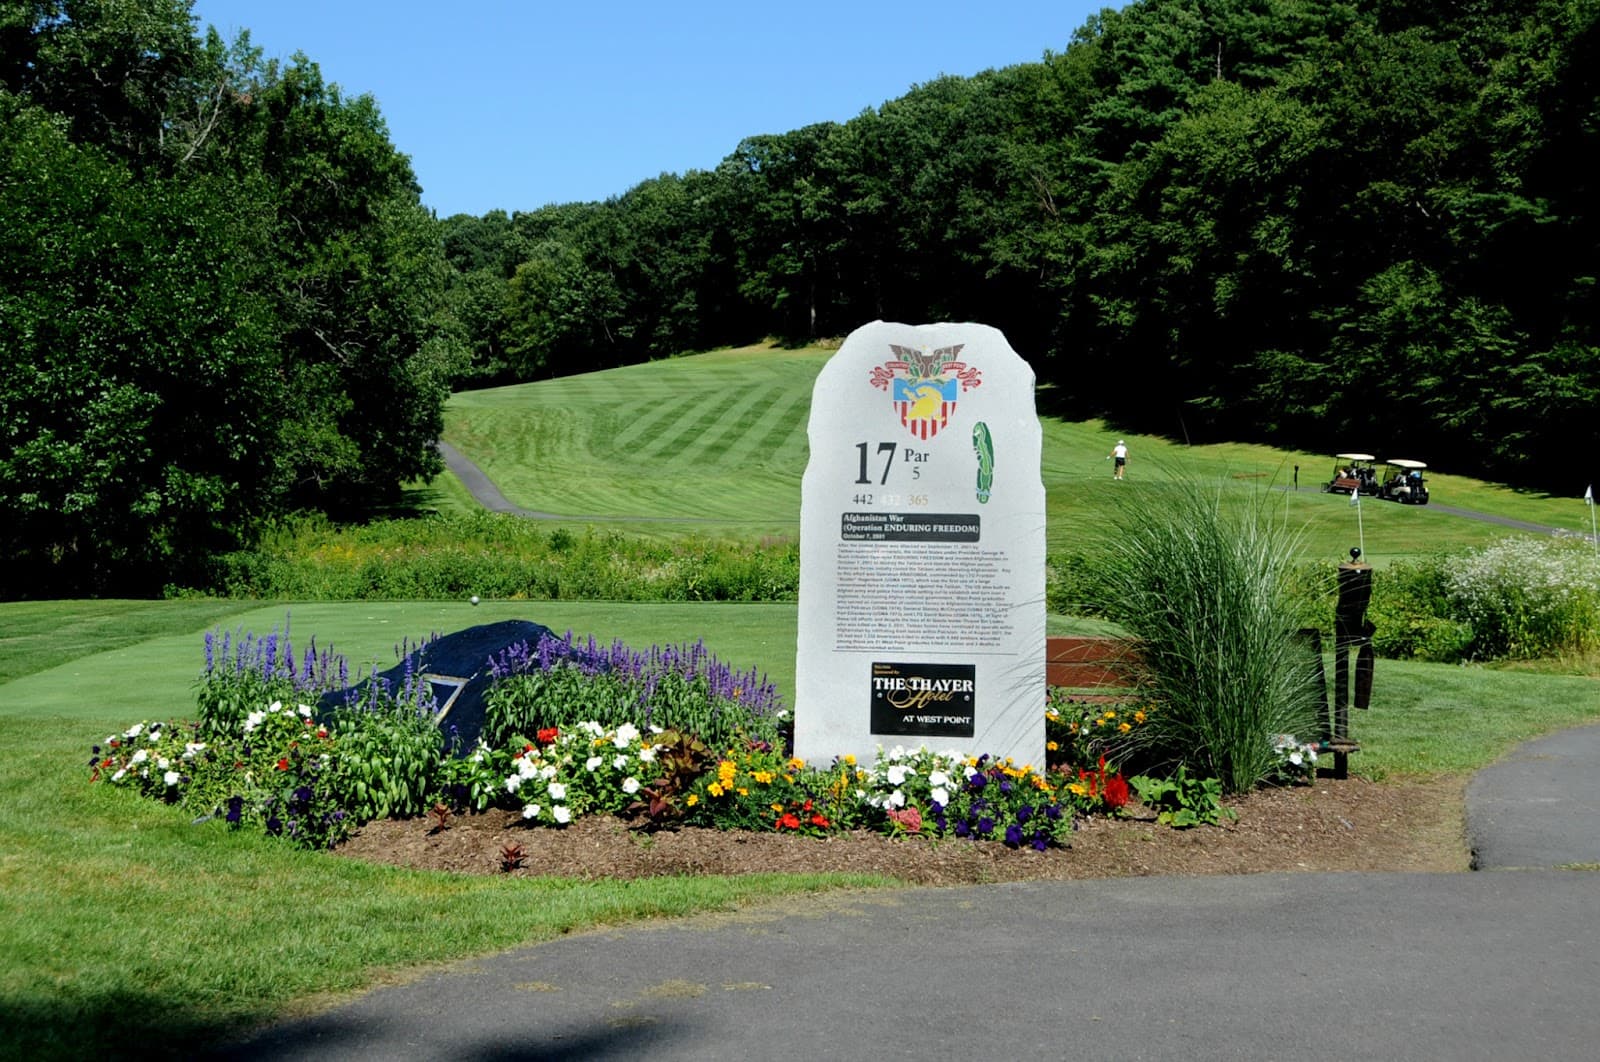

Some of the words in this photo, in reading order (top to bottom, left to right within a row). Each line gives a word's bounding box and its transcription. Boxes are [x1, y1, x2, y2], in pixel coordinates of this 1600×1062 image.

[904, 448, 930, 462] Par
[855, 441, 897, 485] 17
[912, 466, 920, 480] 5
[852, 493, 873, 505] 442
[908, 494, 929, 506] 365
[843, 513, 888, 523] Afghanistan
[889, 514, 905, 523] War
[843, 523, 883, 533] (Operation
[884, 523, 932, 533] ENDURING
[933, 524, 979, 534] FREEDOM)
[873, 677, 906, 690] THE
[909, 679, 974, 692] THAYER
[887, 676, 954, 709] Hotel
[902, 715, 915, 723] AT
[916, 715, 942, 723] WEST
[943, 716, 971, 724] POINT
